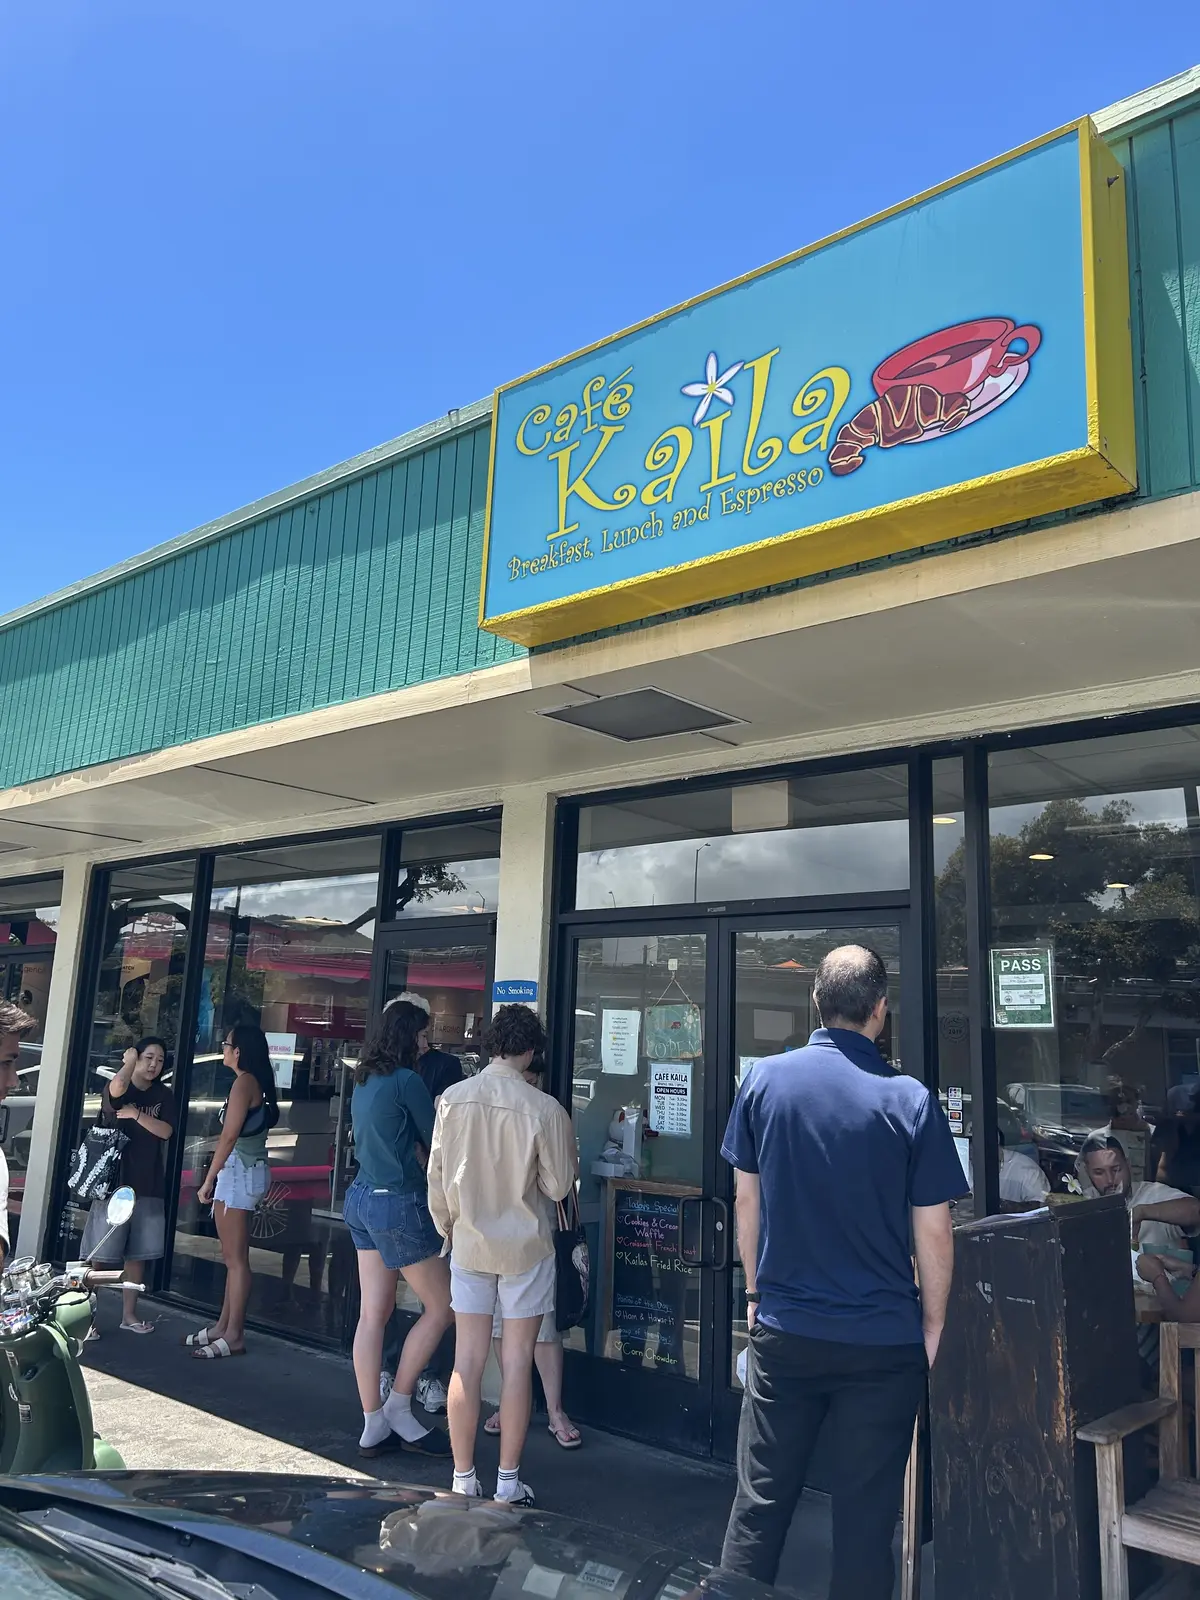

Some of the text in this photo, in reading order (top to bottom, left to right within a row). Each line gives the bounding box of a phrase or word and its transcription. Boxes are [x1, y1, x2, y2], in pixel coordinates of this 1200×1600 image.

[515, 366, 634, 456] Café
[546, 347, 851, 541] Kaila
[508, 467, 824, 581] Breakfast, Lunch and Espresso
[1001, 958, 1041, 971] PASS
[496, 986, 534, 996] No Smoking
[654, 1073, 688, 1082] CAFE KAILA
[624, 1214, 649, 1227] Cookies
[651, 1218, 658, 1227] &
[634, 1227, 664, 1239] Waffle
[623, 1236, 652, 1248] Croissant
[655, 1240, 677, 1253] French
[650, 1254, 671, 1270] Fried
[674, 1259, 692, 1274] Rice
[623, 1310, 638, 1320] Ham
[623, 1342, 678, 1364] Corn Chowder
